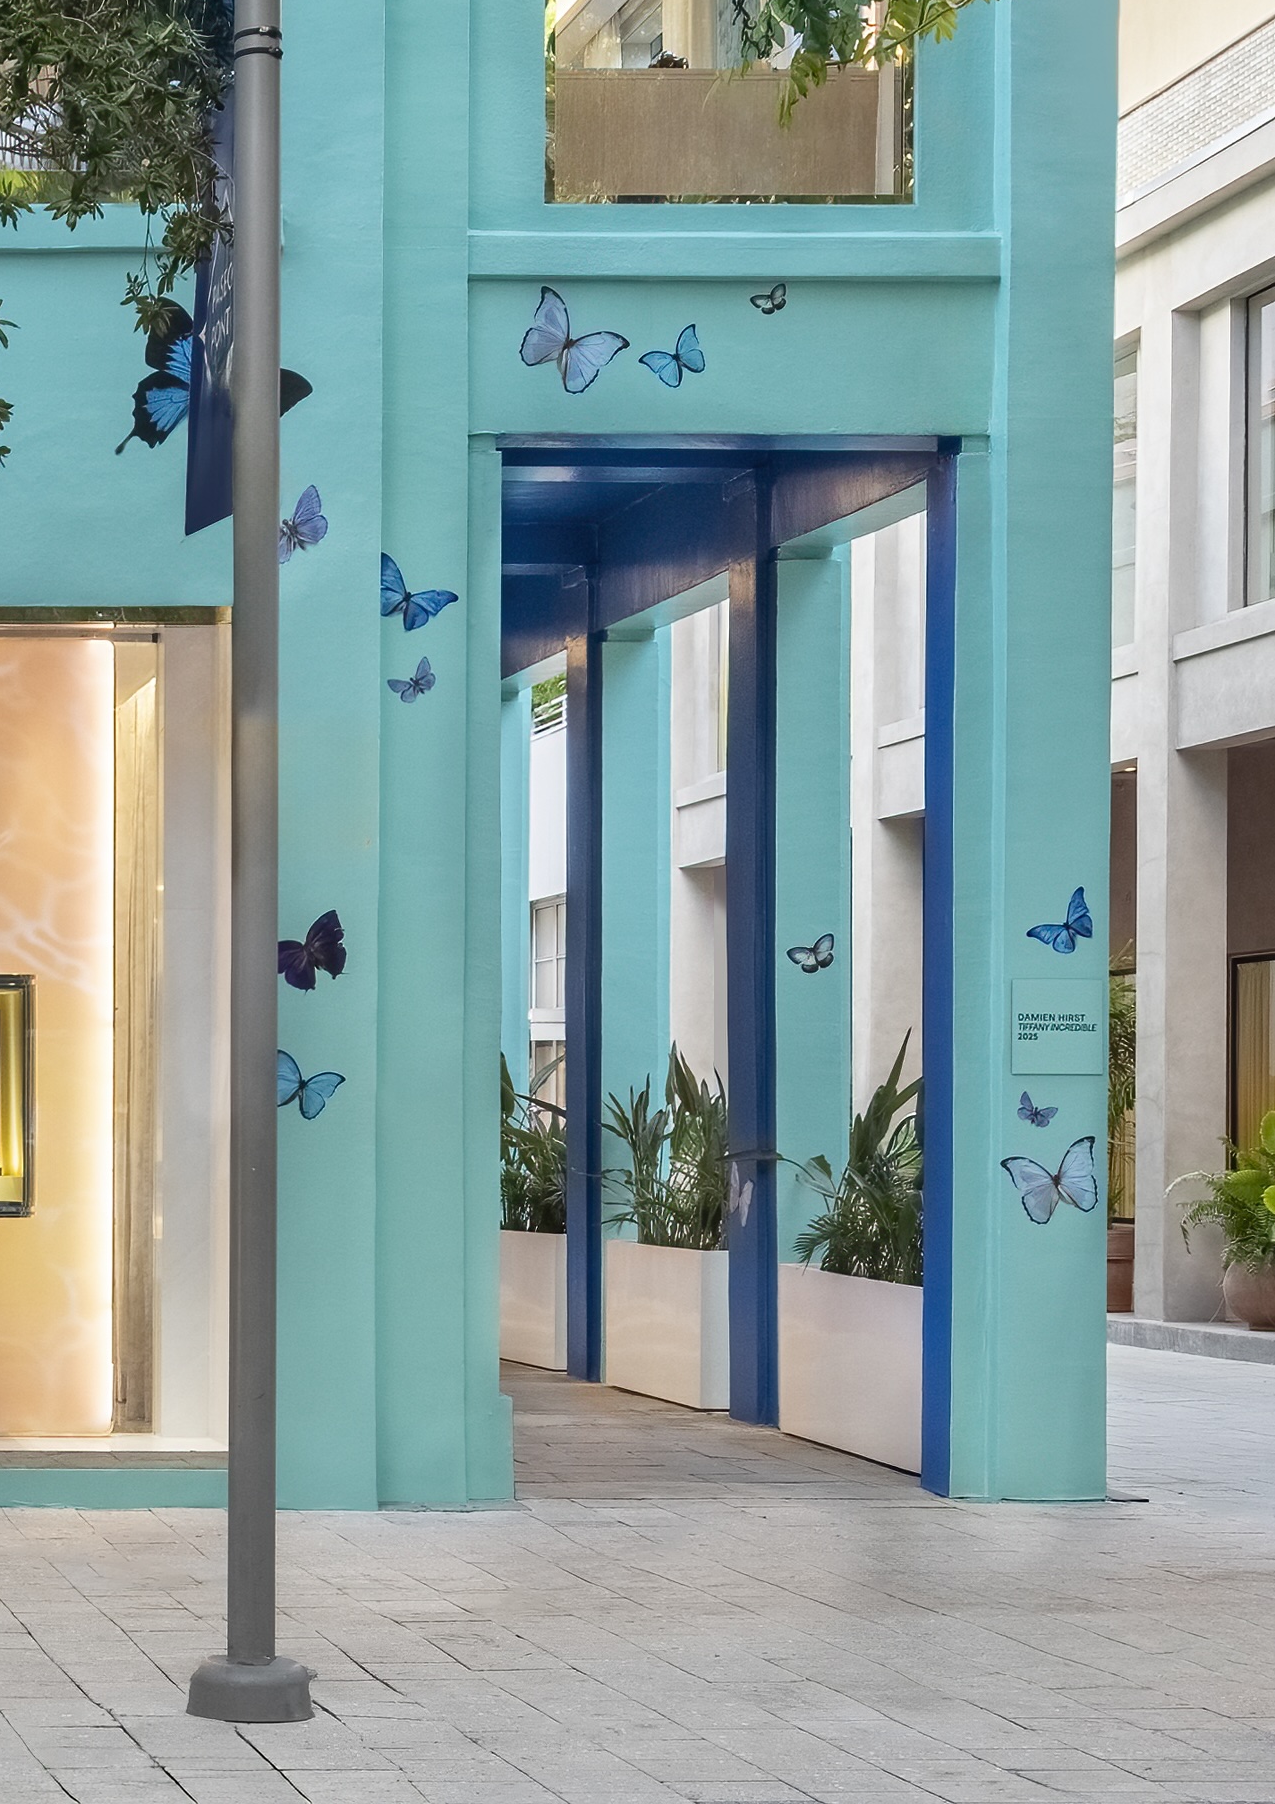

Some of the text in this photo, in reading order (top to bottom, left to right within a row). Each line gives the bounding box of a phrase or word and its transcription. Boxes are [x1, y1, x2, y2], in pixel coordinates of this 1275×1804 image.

[1017, 1012, 1086, 1022] DAMIEN HIRST
[1018, 1023, 1098, 1032] TIFFANY INCREDIBLE
[1017, 1032, 1039, 1041] 2025
